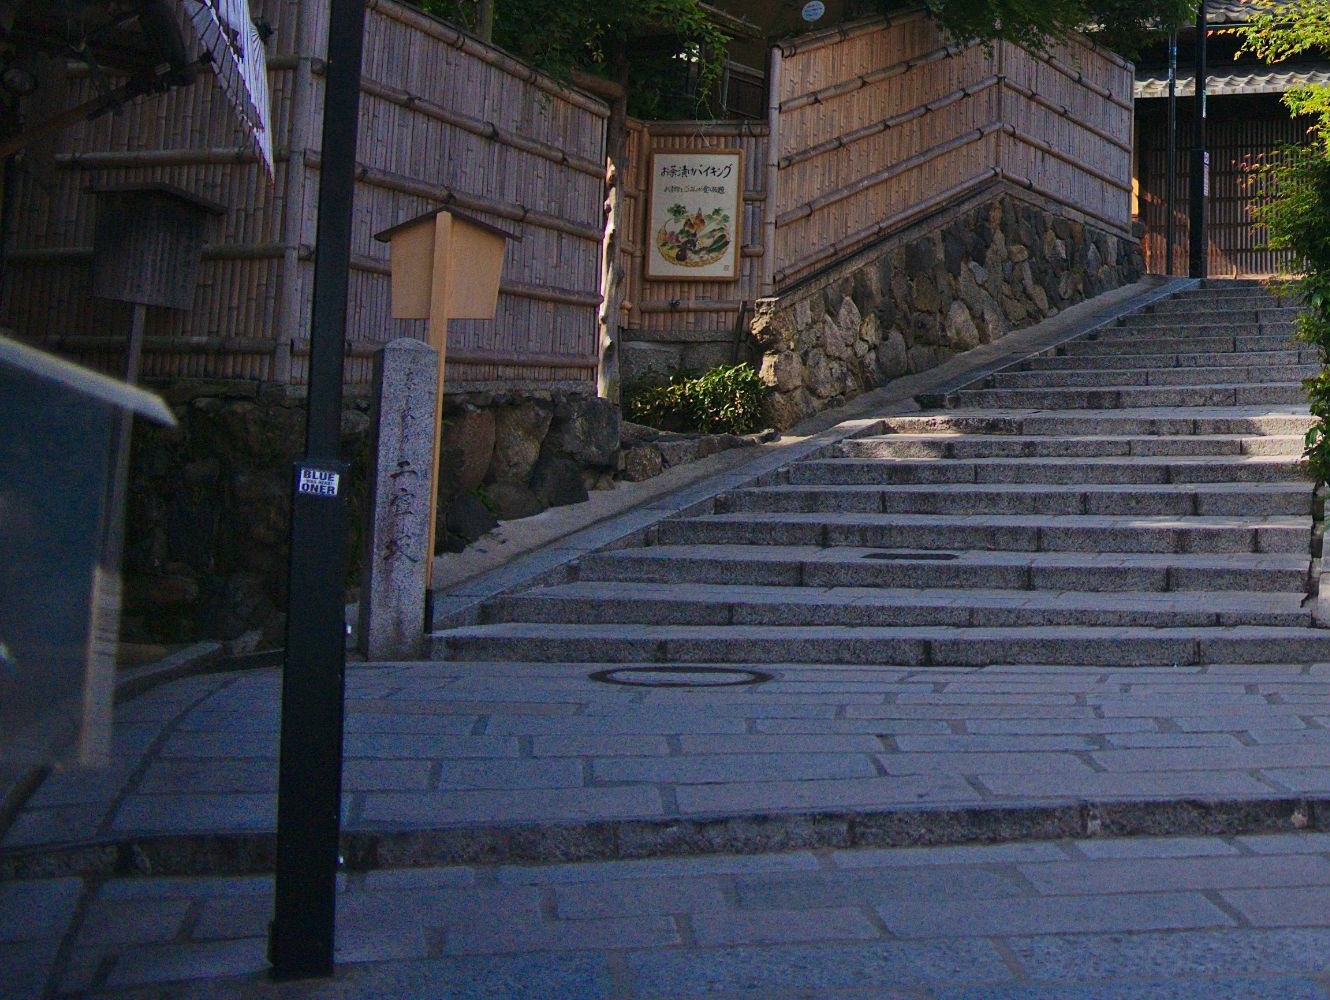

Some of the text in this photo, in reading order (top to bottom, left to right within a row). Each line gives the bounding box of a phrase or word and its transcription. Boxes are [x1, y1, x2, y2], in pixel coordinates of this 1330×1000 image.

[660, 163, 734, 179] お茶漬けバイキング
[303, 469, 336, 482] BLUE
[301, 483, 336, 495] ONER
